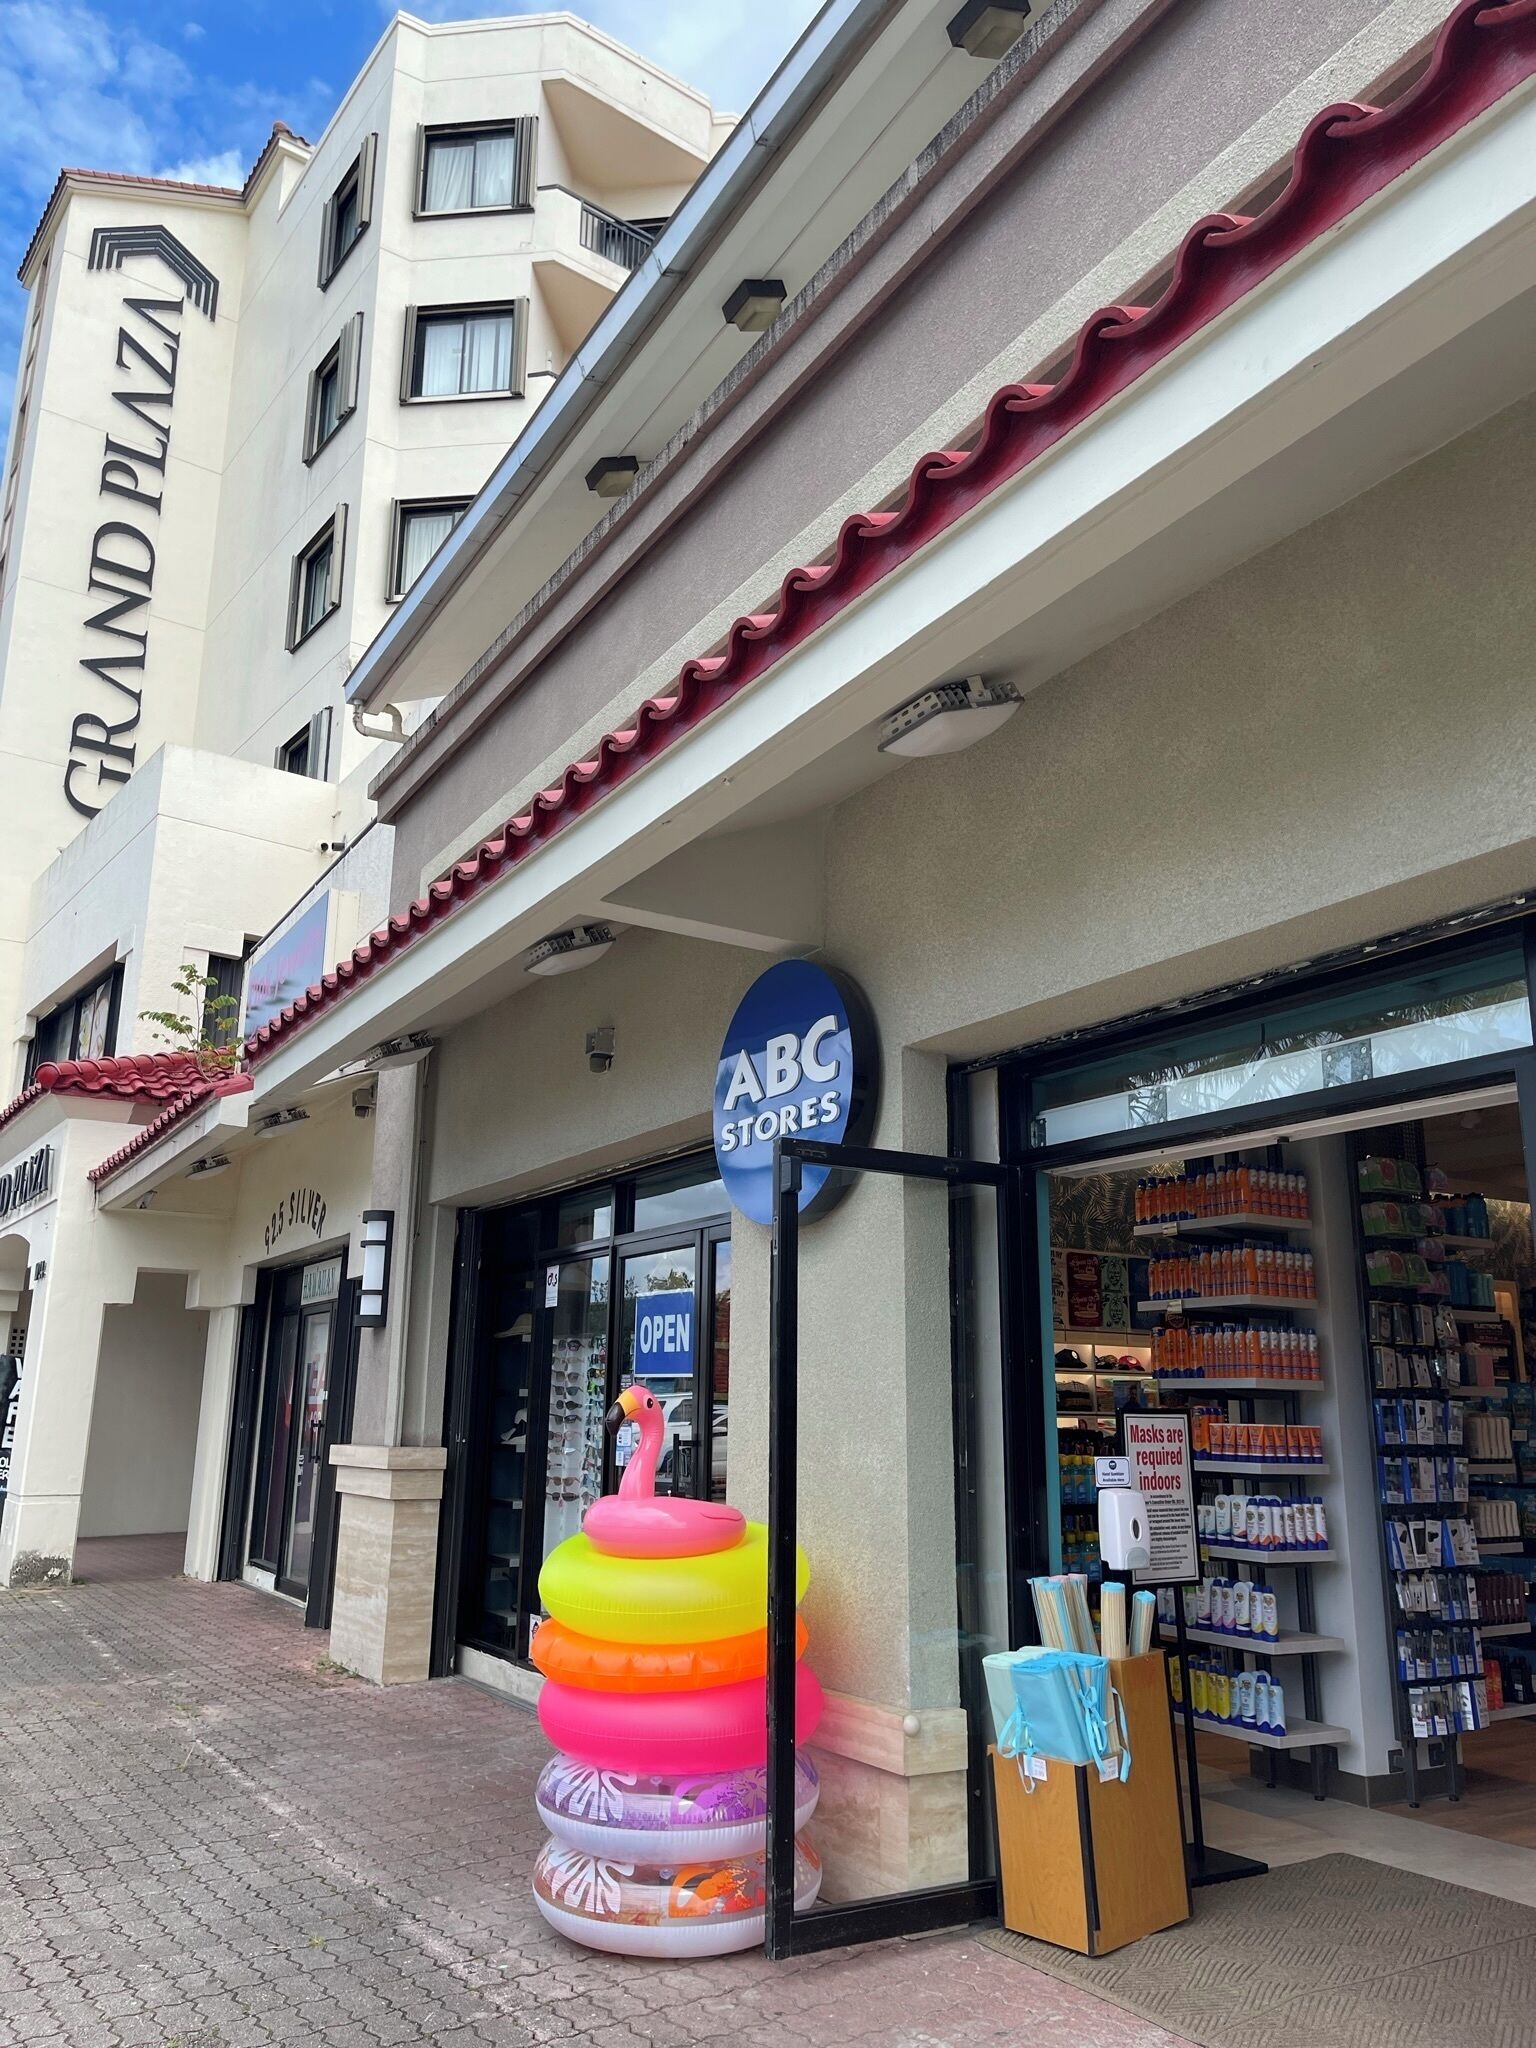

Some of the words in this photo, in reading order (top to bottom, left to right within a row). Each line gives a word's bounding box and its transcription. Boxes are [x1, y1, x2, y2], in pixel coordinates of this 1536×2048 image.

[99, 296, 185, 516] PLAZA
[63, 519, 156, 821] GRAND
[722, 1014, 841, 1111] ABC
[720, 1090, 841, 1152] STORES
[288, 1187, 327, 1239] SILVER
[639, 1313, 690, 1354] OPEN
[1129, 1423, 1165, 1444] Masks
[1166, 1428, 1184, 1444] are
[1136, 1446, 1183, 1471] required
[1138, 1471, 1182, 1491] indoors
